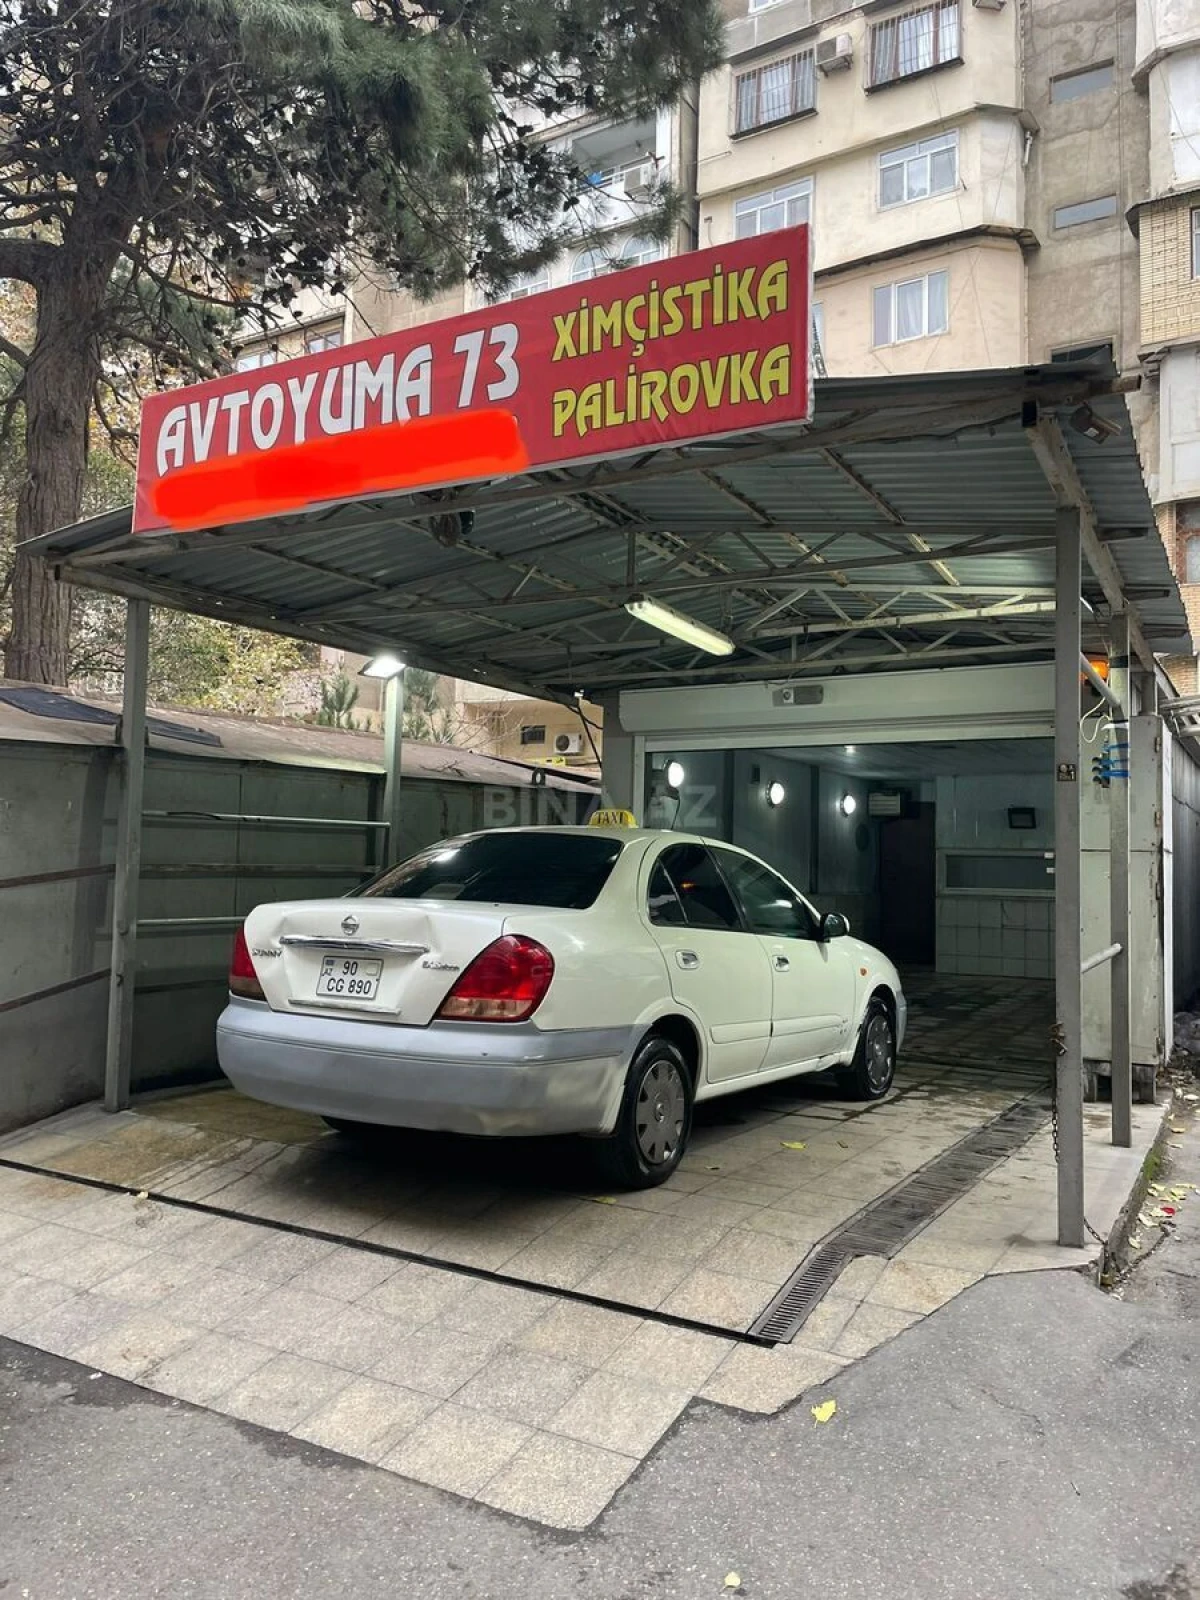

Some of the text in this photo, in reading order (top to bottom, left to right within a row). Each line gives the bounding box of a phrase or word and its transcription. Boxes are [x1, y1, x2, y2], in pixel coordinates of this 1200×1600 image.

[552, 259, 789, 357] XİMÇİSTİKA
[156, 323, 520, 477] AVTOYUMA 73
[553, 343, 791, 437] PALİROVKA
[596, 811, 624, 824] TAXI
[326, 977, 373, 995] CG 890
[342, 961, 358, 976] 90
